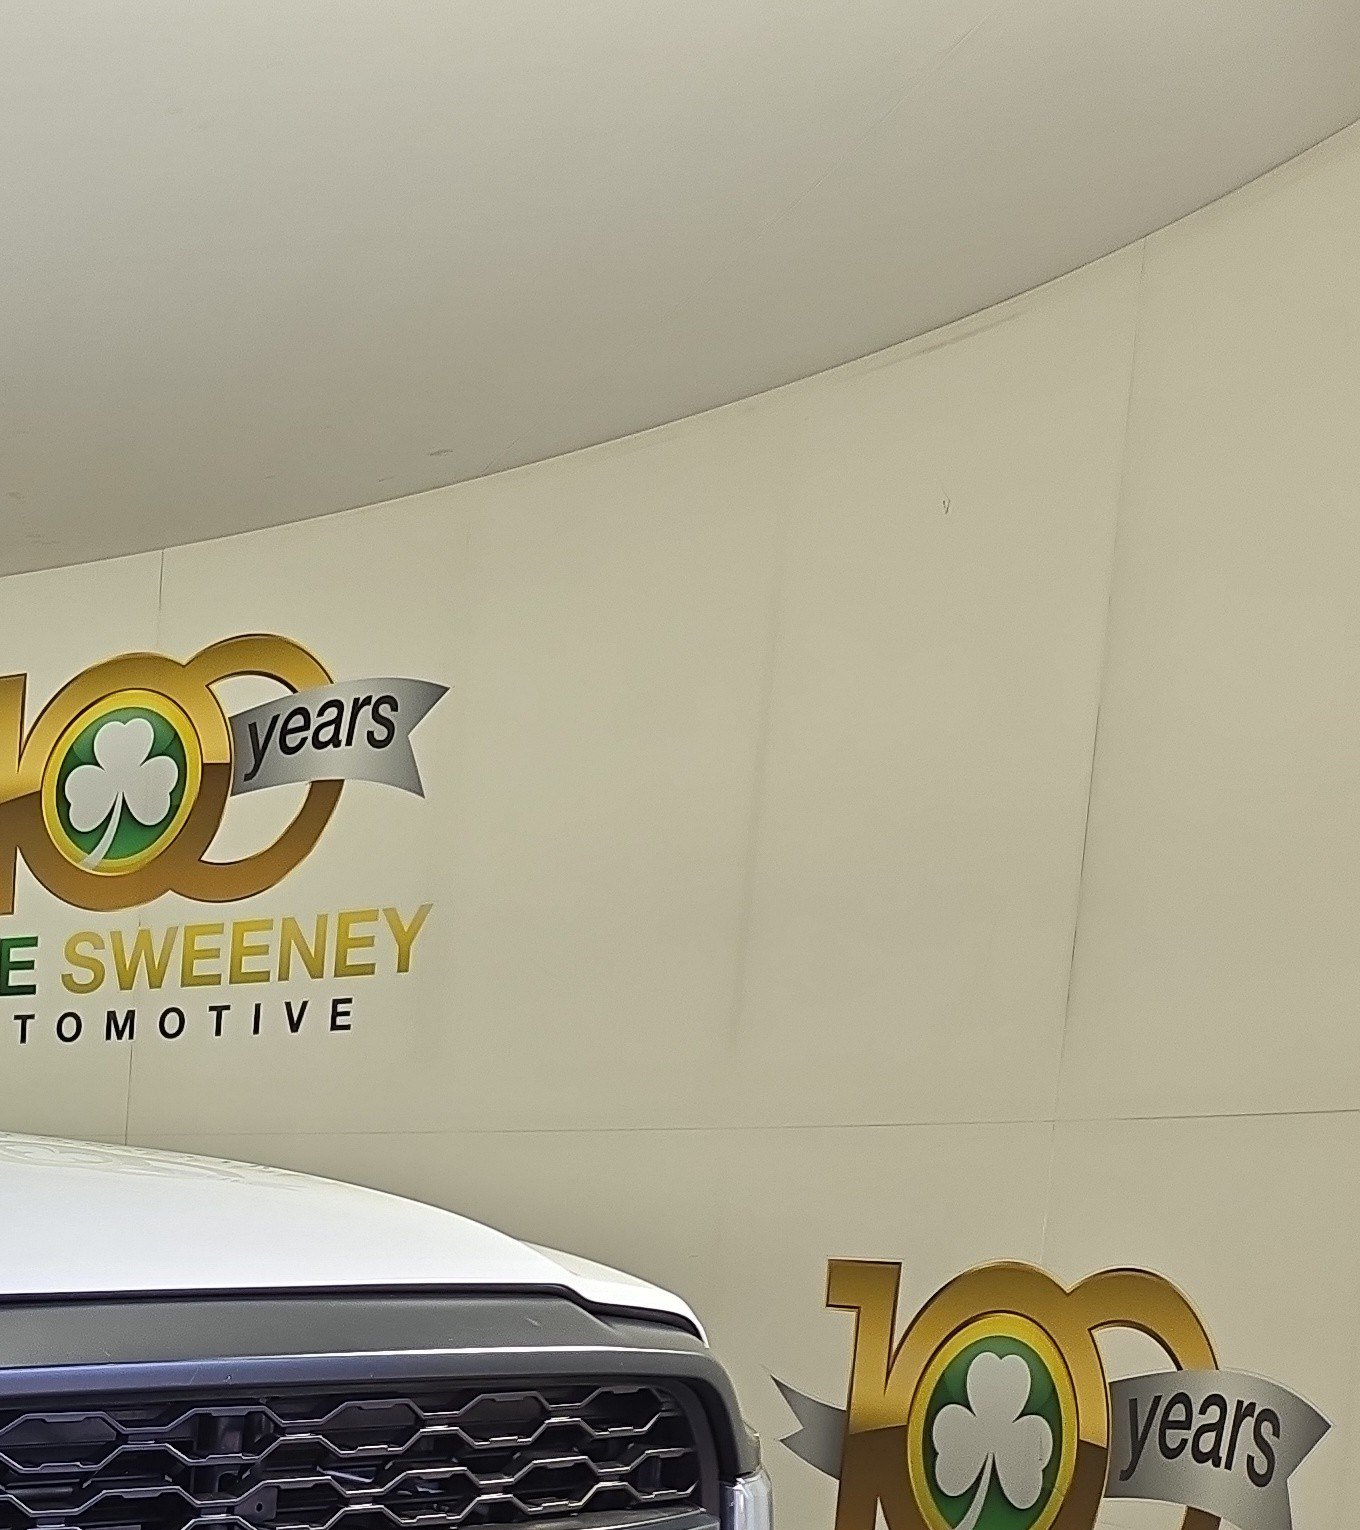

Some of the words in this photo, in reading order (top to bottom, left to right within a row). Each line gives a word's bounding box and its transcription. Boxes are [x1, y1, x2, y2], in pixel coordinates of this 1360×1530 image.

[243, 693, 400, 784] years
[60, 903, 434, 996] SWEENEY
[1118, 1390, 1282, 1489] years
